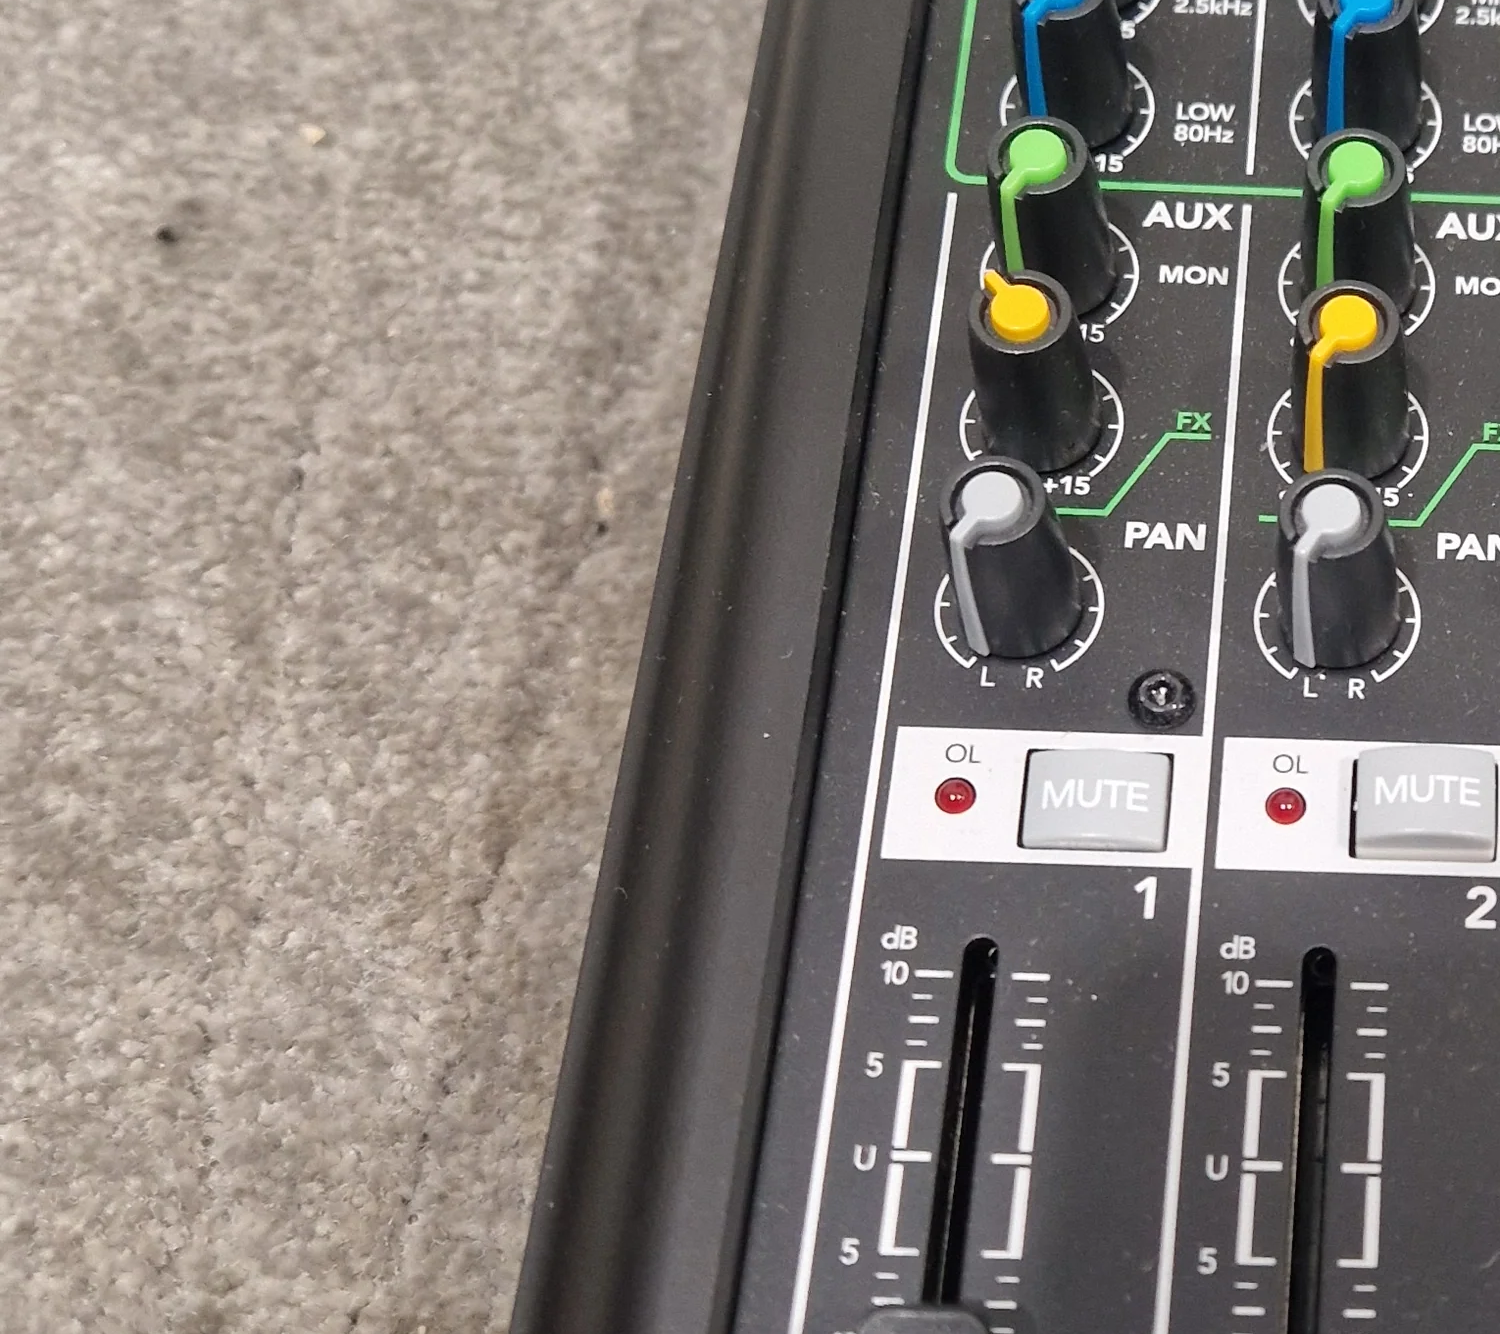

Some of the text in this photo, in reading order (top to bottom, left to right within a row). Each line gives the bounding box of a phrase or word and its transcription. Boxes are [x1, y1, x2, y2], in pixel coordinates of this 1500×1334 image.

[1176, 102, 1235, 123] LOW
[1173, 124, 1235, 145] 80Hz
[1143, 202, 1233, 230] AUX
[1159, 265, 1230, 285] MON
[1175, 411, 1211, 432] FX
[1124, 521, 1206, 551] PAN
[946, 743, 981, 765] OL
[1273, 754, 1309, 775] OL
[1041, 780, 1150, 812] MUTE
[1374, 775, 1481, 807] MUTE
[1134, 877, 1158, 920] 1
[1464, 886, 1498, 929] 2
